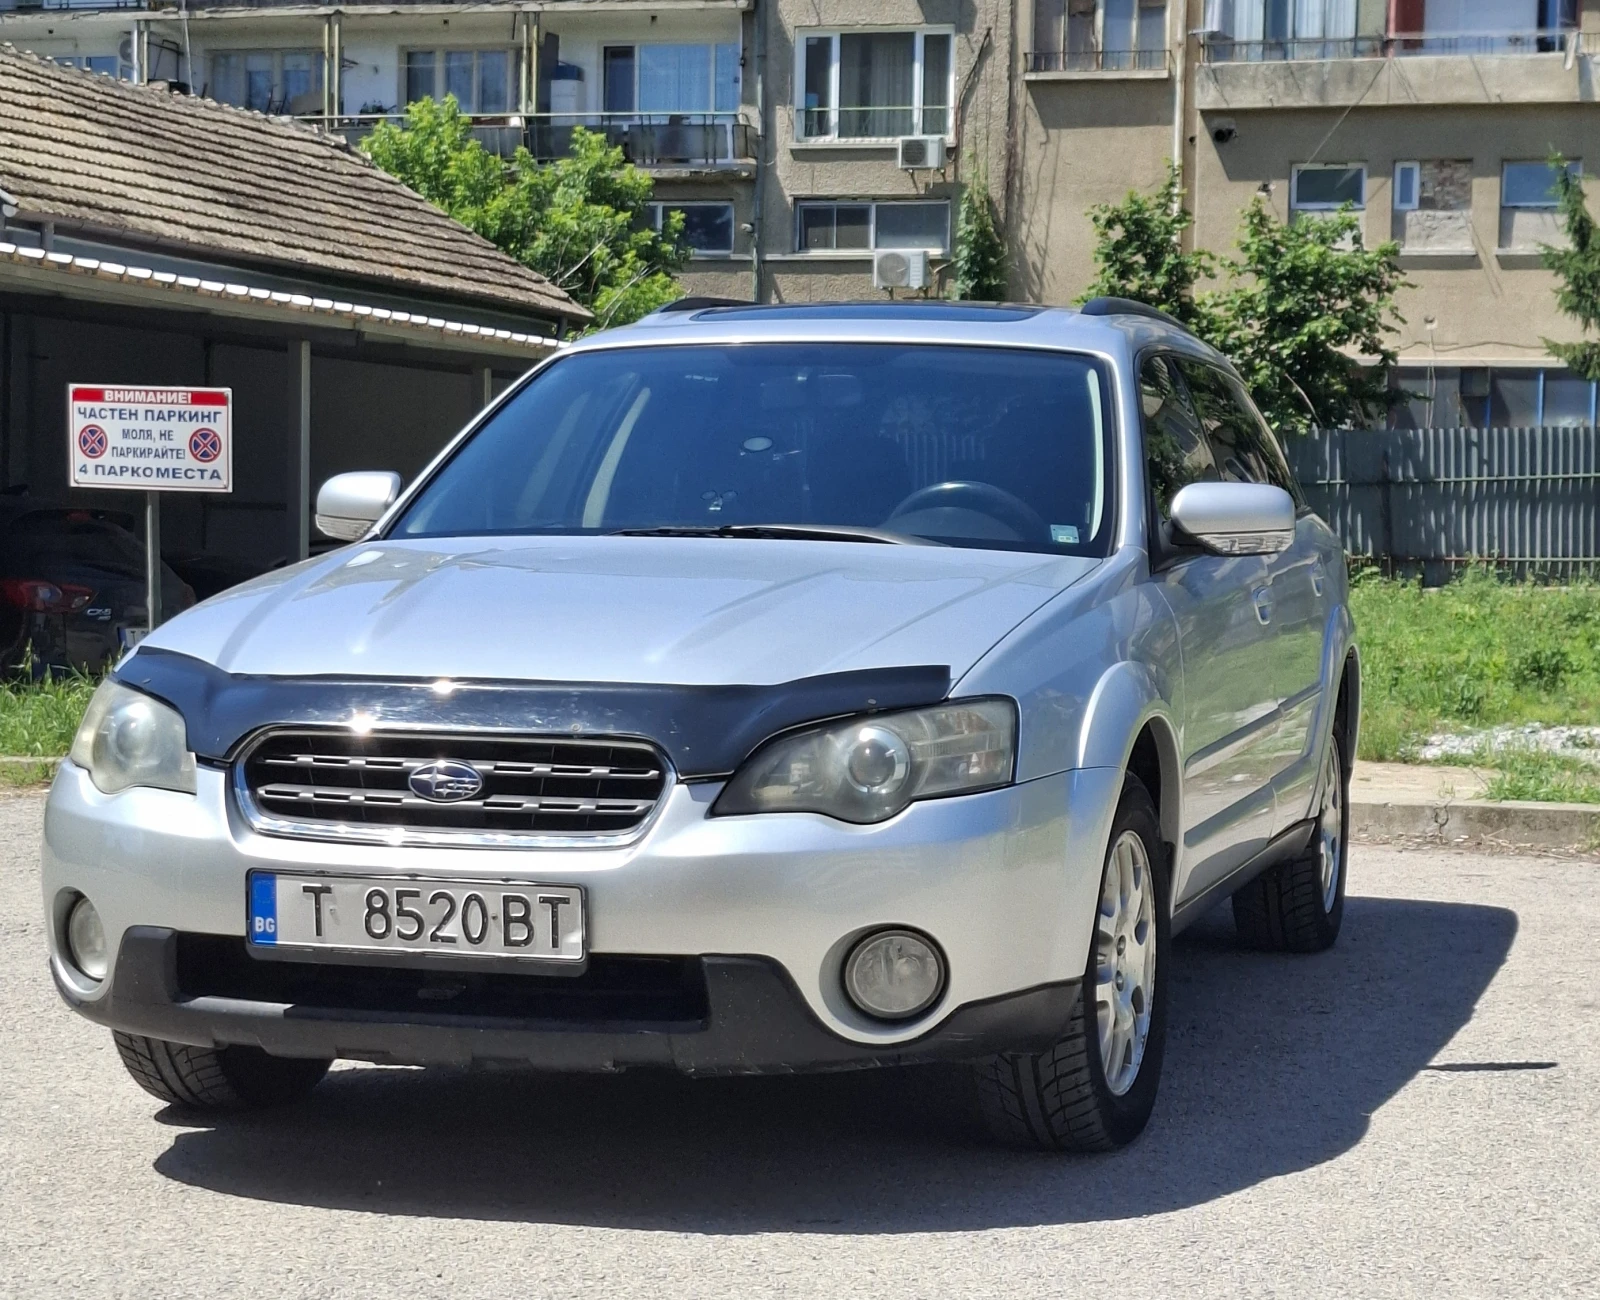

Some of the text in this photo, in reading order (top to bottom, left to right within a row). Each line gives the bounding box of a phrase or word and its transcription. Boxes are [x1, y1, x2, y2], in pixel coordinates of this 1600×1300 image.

[104, 390, 192, 404] ВНИМАНИЕ!
[78, 407, 222, 423] ЧАСТЕН ПАРКИНГ
[122, 428, 174, 443] МОЛЯ, НЕ
[111, 446, 186, 460] ПАРКИРАЙТЕ!
[79, 464, 222, 480] 4 ПАРКОМЕСТА
[254, 915, 275, 933] BG
[302, 884, 570, 949] T 8520 BT
